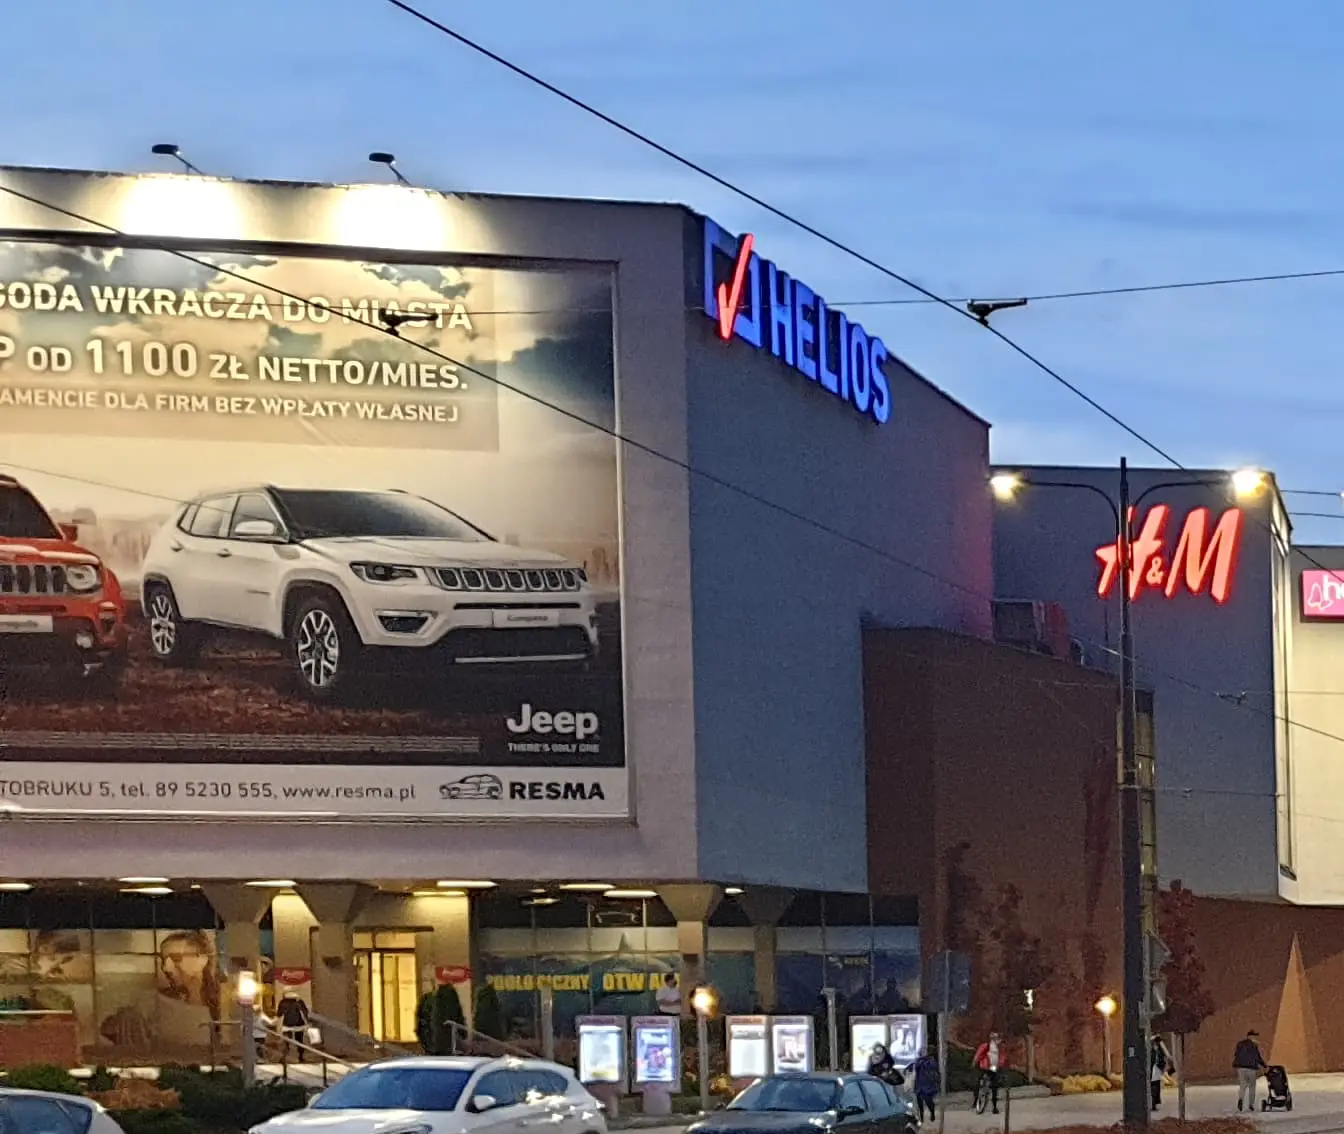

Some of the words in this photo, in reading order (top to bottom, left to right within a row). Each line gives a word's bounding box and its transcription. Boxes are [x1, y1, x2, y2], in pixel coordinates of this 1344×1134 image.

[90, 285, 273, 321] WKRACZA
[282, 295, 330, 323] DO
[768, 260, 893, 425] HELIOS
[27, 345, 72, 372] OD
[86, 338, 199, 378] 1100
[208, 353, 249, 380] ZŁ
[258, 355, 469, 390] NETTO/MIES.
[0, 388, 98, 408] AMENCIE
[104, 391, 149, 410] DLA
[155, 394, 209, 413] FIRM
[215, 396, 257, 415] BEZ
[262, 397, 350, 418] WPŁATY
[355, 401, 459, 423] WŁASNEJ
[1095, 504, 1244, 605] H&M
[506, 703, 599, 740] Jeep
[0, 780, 92, 796] TOBRUKU
[155, 782, 178, 797] 89
[185, 782, 231, 798] 5230
[509, 781, 605, 800] RESMA
